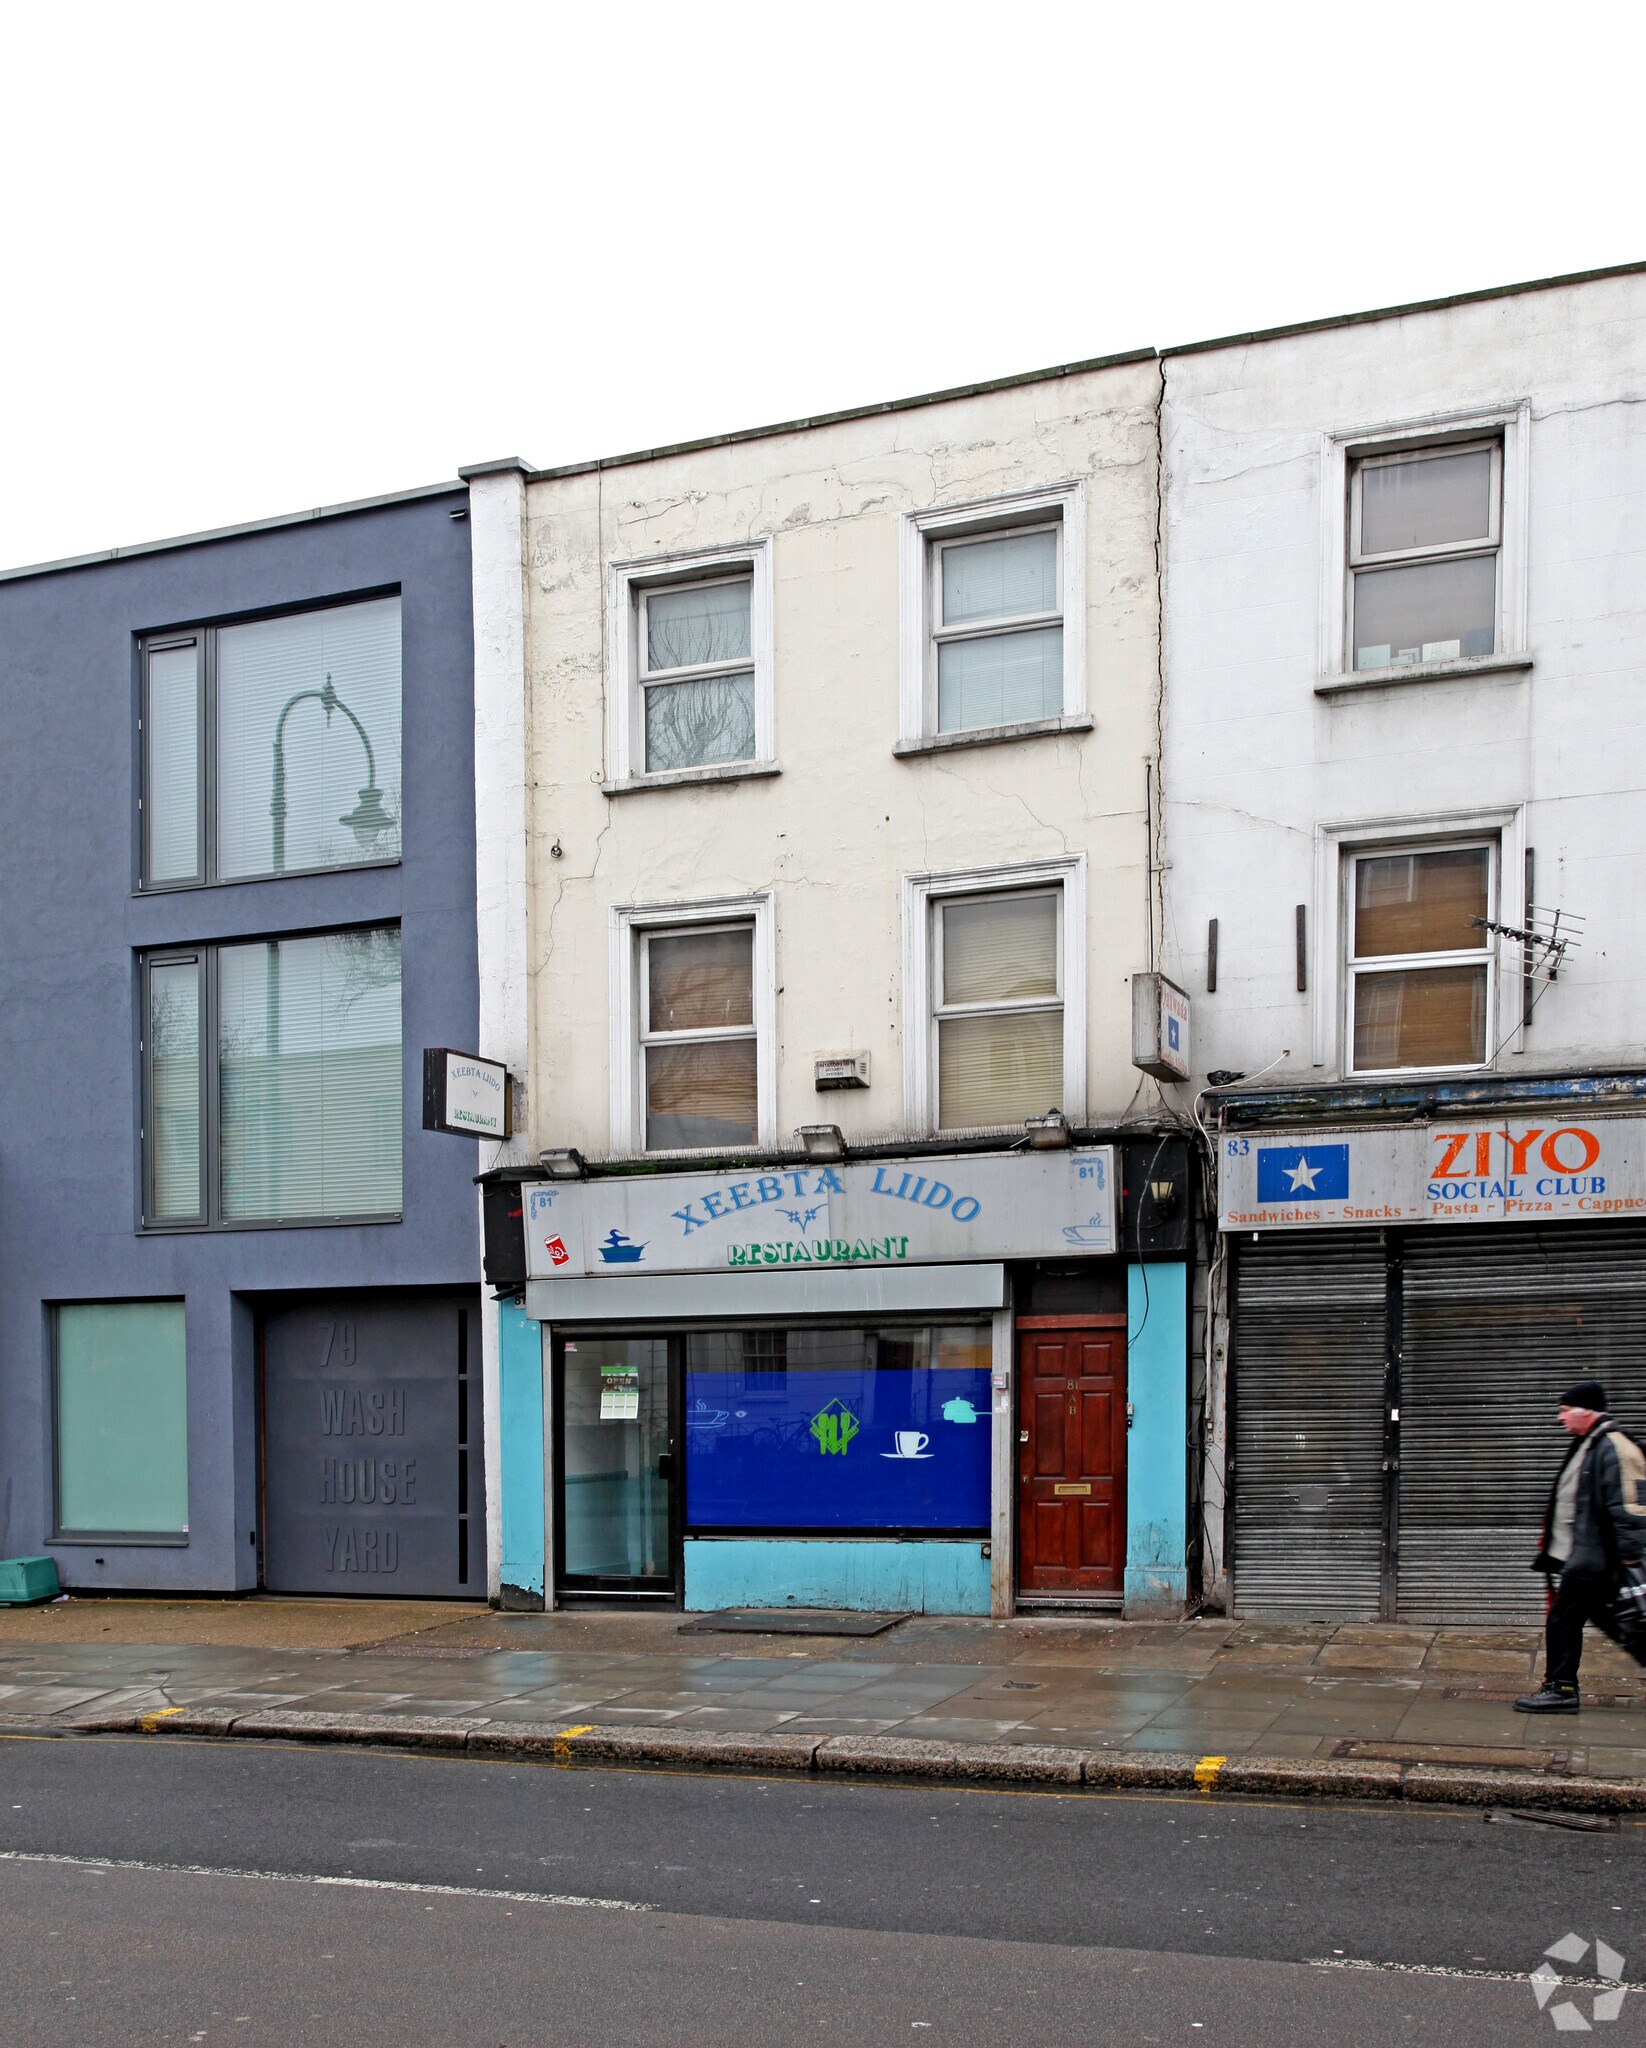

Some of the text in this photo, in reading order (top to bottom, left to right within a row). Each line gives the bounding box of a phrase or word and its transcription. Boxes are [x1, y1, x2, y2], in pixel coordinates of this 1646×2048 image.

[451, 1066, 501, 1092] XEEBTA LIIDO
[1227, 1139, 1250, 1157] 83
[1431, 1127, 1600, 1179] ZIYO
[1079, 1166, 1094, 1179] 81
[1427, 1176, 1606, 1201] SOCIAL CLUB
[539, 1197, 552, 1208] 81
[671, 1167, 982, 1236] XEEBTA LIIDO
[1227, 1208, 1321, 1224] Sandwiches
[1343, 1205, 1402, 1219] Snacks
[1432, 1203, 1479, 1215] Pasta
[1506, 1200, 1553, 1212] Pizza
[726, 1236, 909, 1266] RESTAURANT
[316, 1320, 358, 1368] 79
[606, 1377, 632, 1385] OPEN
[1067, 1380, 1078, 1391] 81
[320, 1389, 406, 1437] WASH
[1069, 1406, 1077, 1415] B
[320, 1459, 416, 1505] HOUSE
[324, 1527, 399, 1574] YARD
